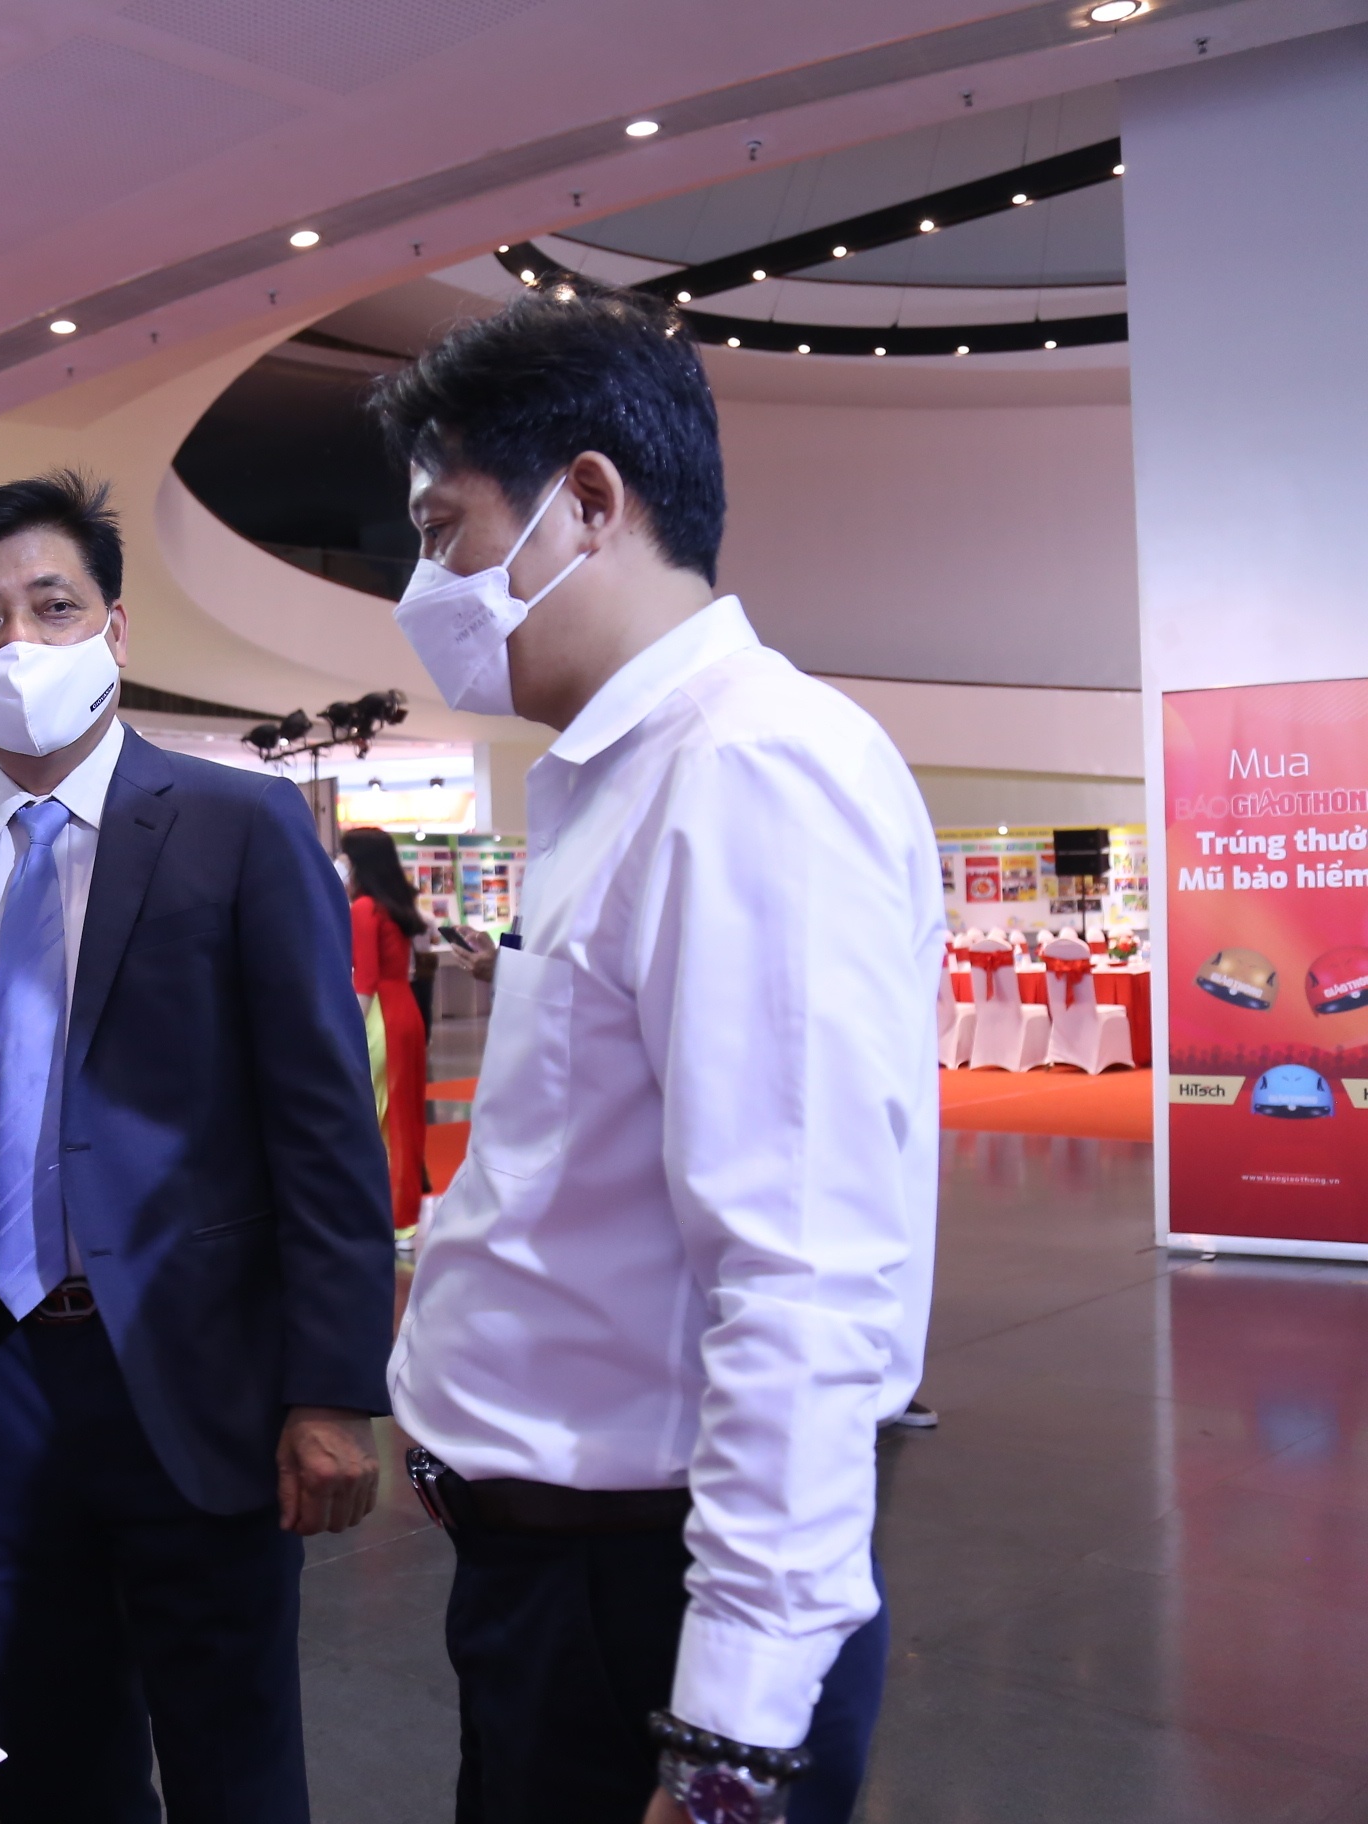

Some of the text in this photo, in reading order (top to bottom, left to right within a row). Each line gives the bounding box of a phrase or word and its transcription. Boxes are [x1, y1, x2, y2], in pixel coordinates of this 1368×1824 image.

[1228, 748, 1310, 780] Mua
[1196, 829, 1287, 860] Trúng
[1178, 859, 1368, 891] Mũ bảo hiểm
[1179, 1083, 1225, 1097] HiTech
